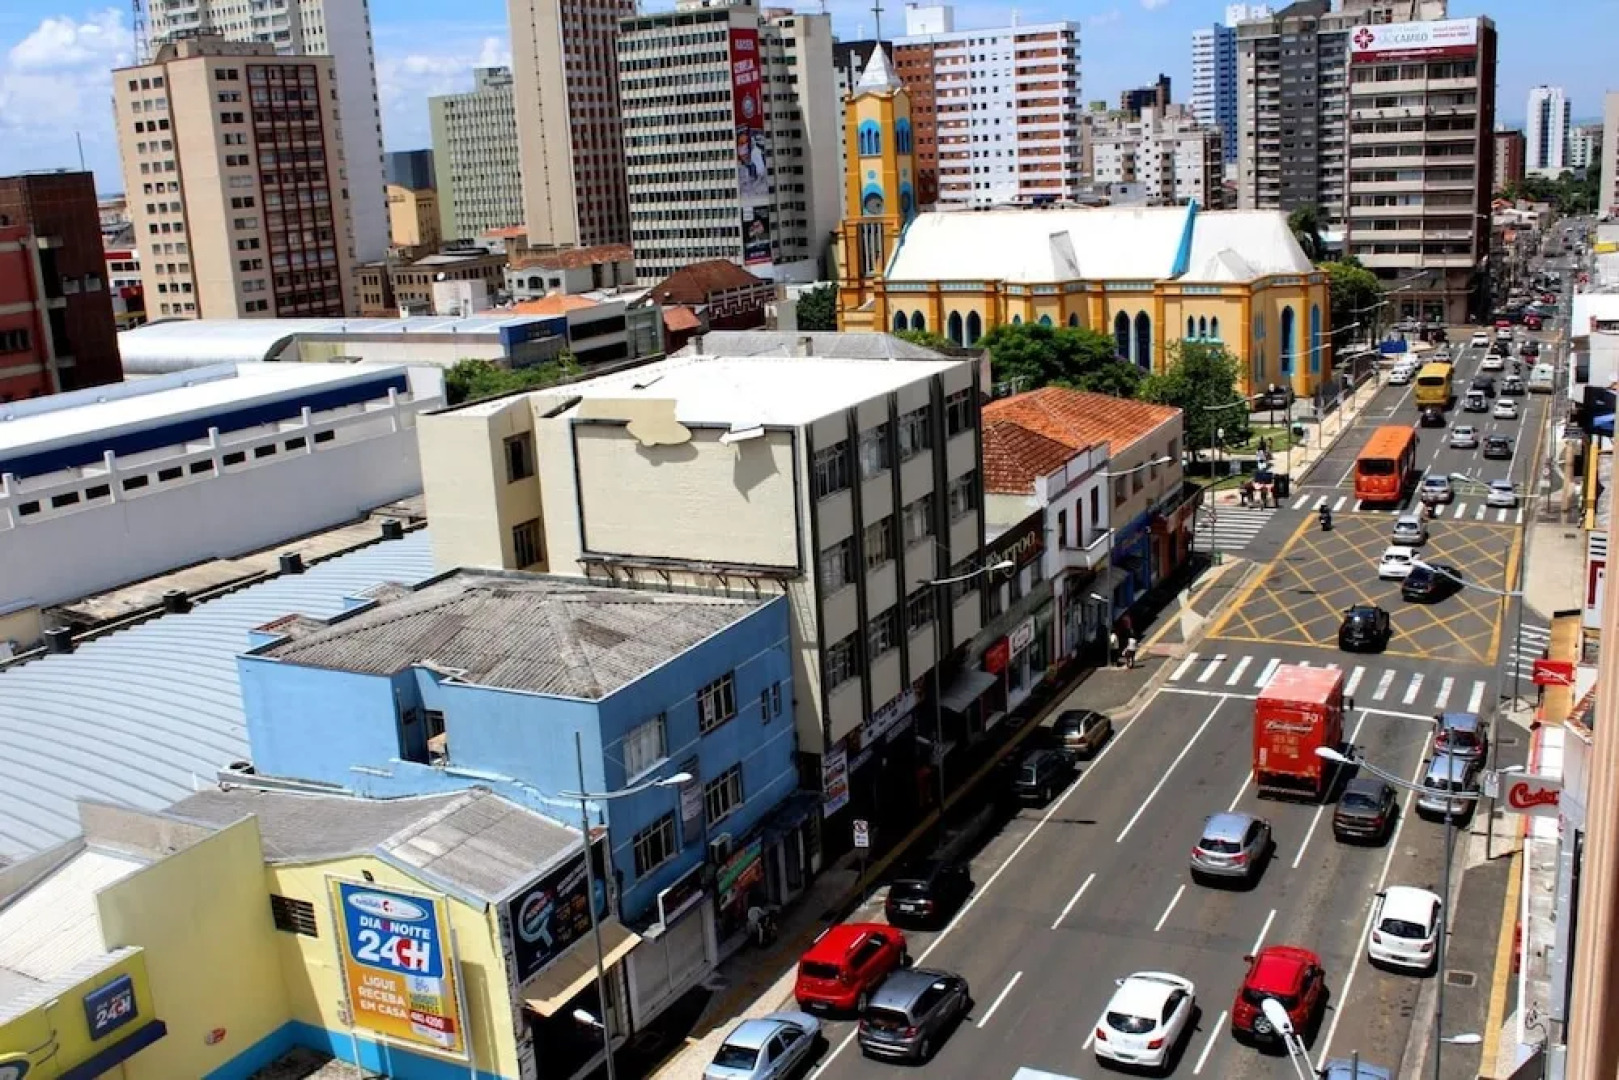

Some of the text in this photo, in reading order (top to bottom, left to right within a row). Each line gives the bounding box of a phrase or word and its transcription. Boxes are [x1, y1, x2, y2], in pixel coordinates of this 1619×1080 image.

[360, 916, 382, 930] DIA
[390, 921, 431, 940] NOITE
[362, 974, 396, 991] LIGUE
[357, 985, 405, 1006] RECEBA
[360, 999, 376, 1012] EM
[377, 1003, 409, 1019] CASA
